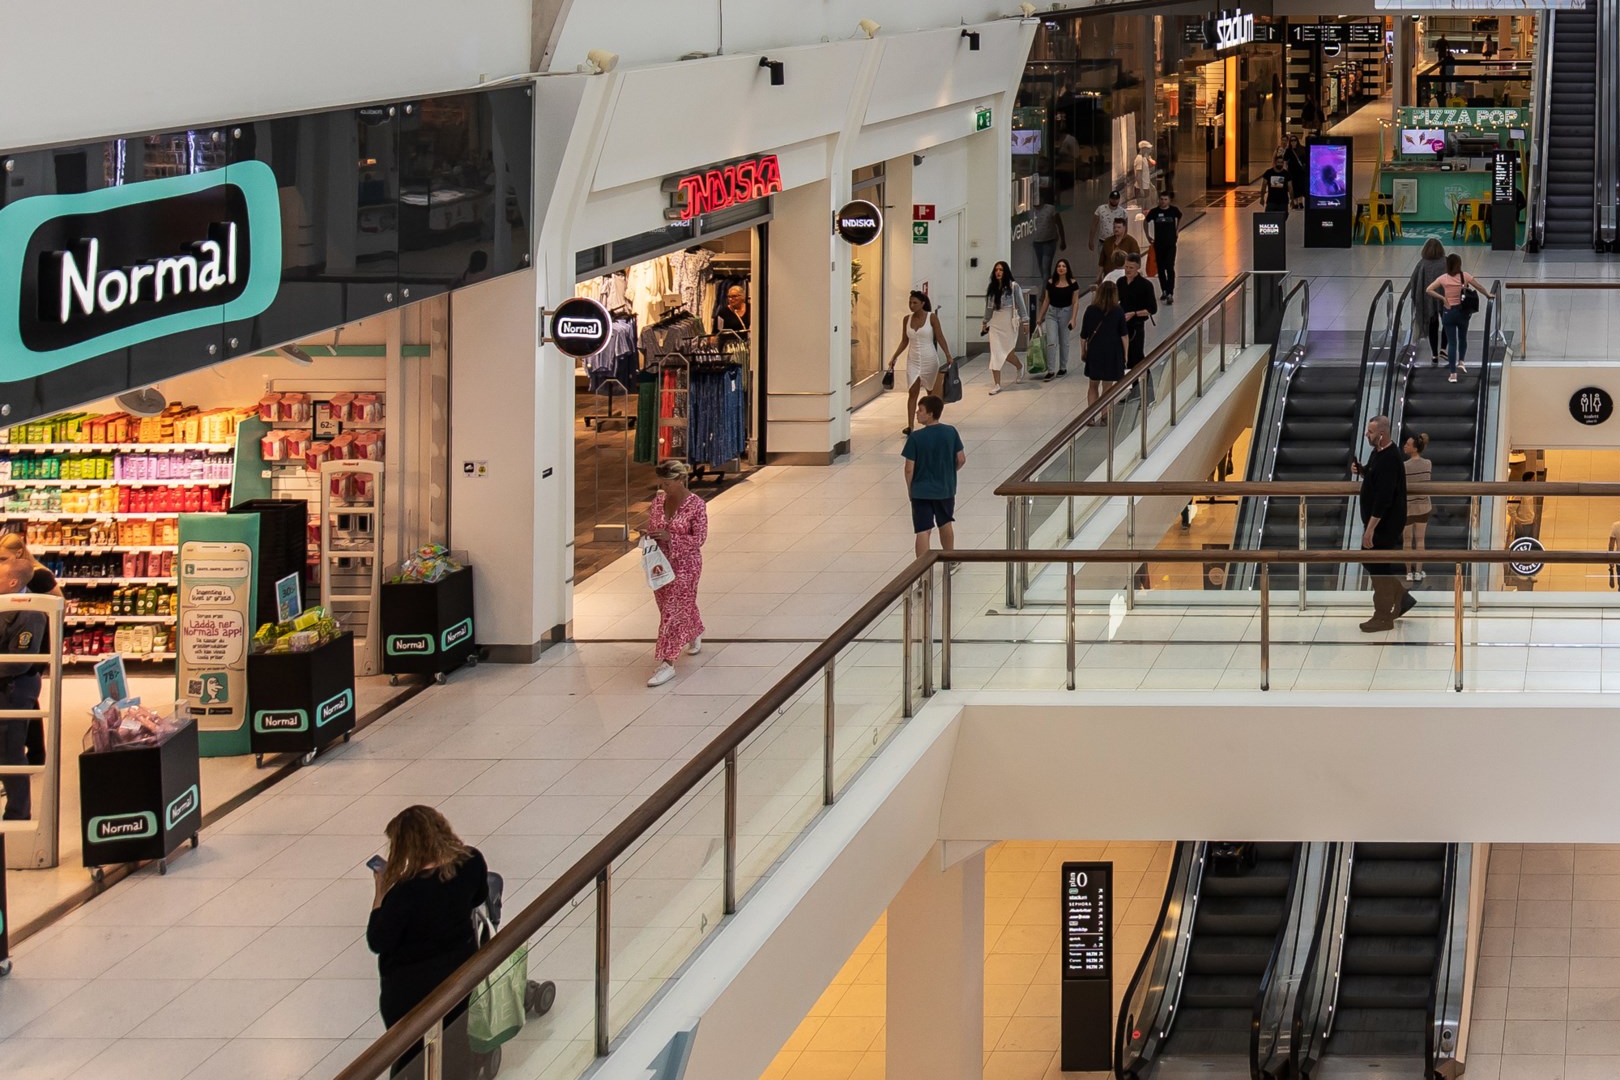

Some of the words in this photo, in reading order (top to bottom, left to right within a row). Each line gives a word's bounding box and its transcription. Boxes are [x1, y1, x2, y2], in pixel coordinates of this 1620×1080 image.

[1216, 8, 1254, 51] stadium
[1293, 26, 1301, 40] 1
[1412, 109, 1472, 126] PIZZA
[1476, 109, 1518, 126] POP
[677, 154, 783, 221] INDISKA
[842, 218, 876, 228] INDISKA
[61, 221, 237, 324] Normal
[562, 321, 598, 335] Normal
[183, 627, 220, 637] Normals
[222, 628, 242, 638] app!
[189, 620, 215, 629] Ladda
[218, 621, 235, 629] ner
[447, 627, 467, 644] Normal
[396, 640, 425, 650] Normal
[323, 697, 345, 718] Normal
[265, 716, 298, 727] Normal
[172, 794, 192, 819] Normal
[102, 818, 143, 836] Normal
[1076, 871, 1088, 888] 0
